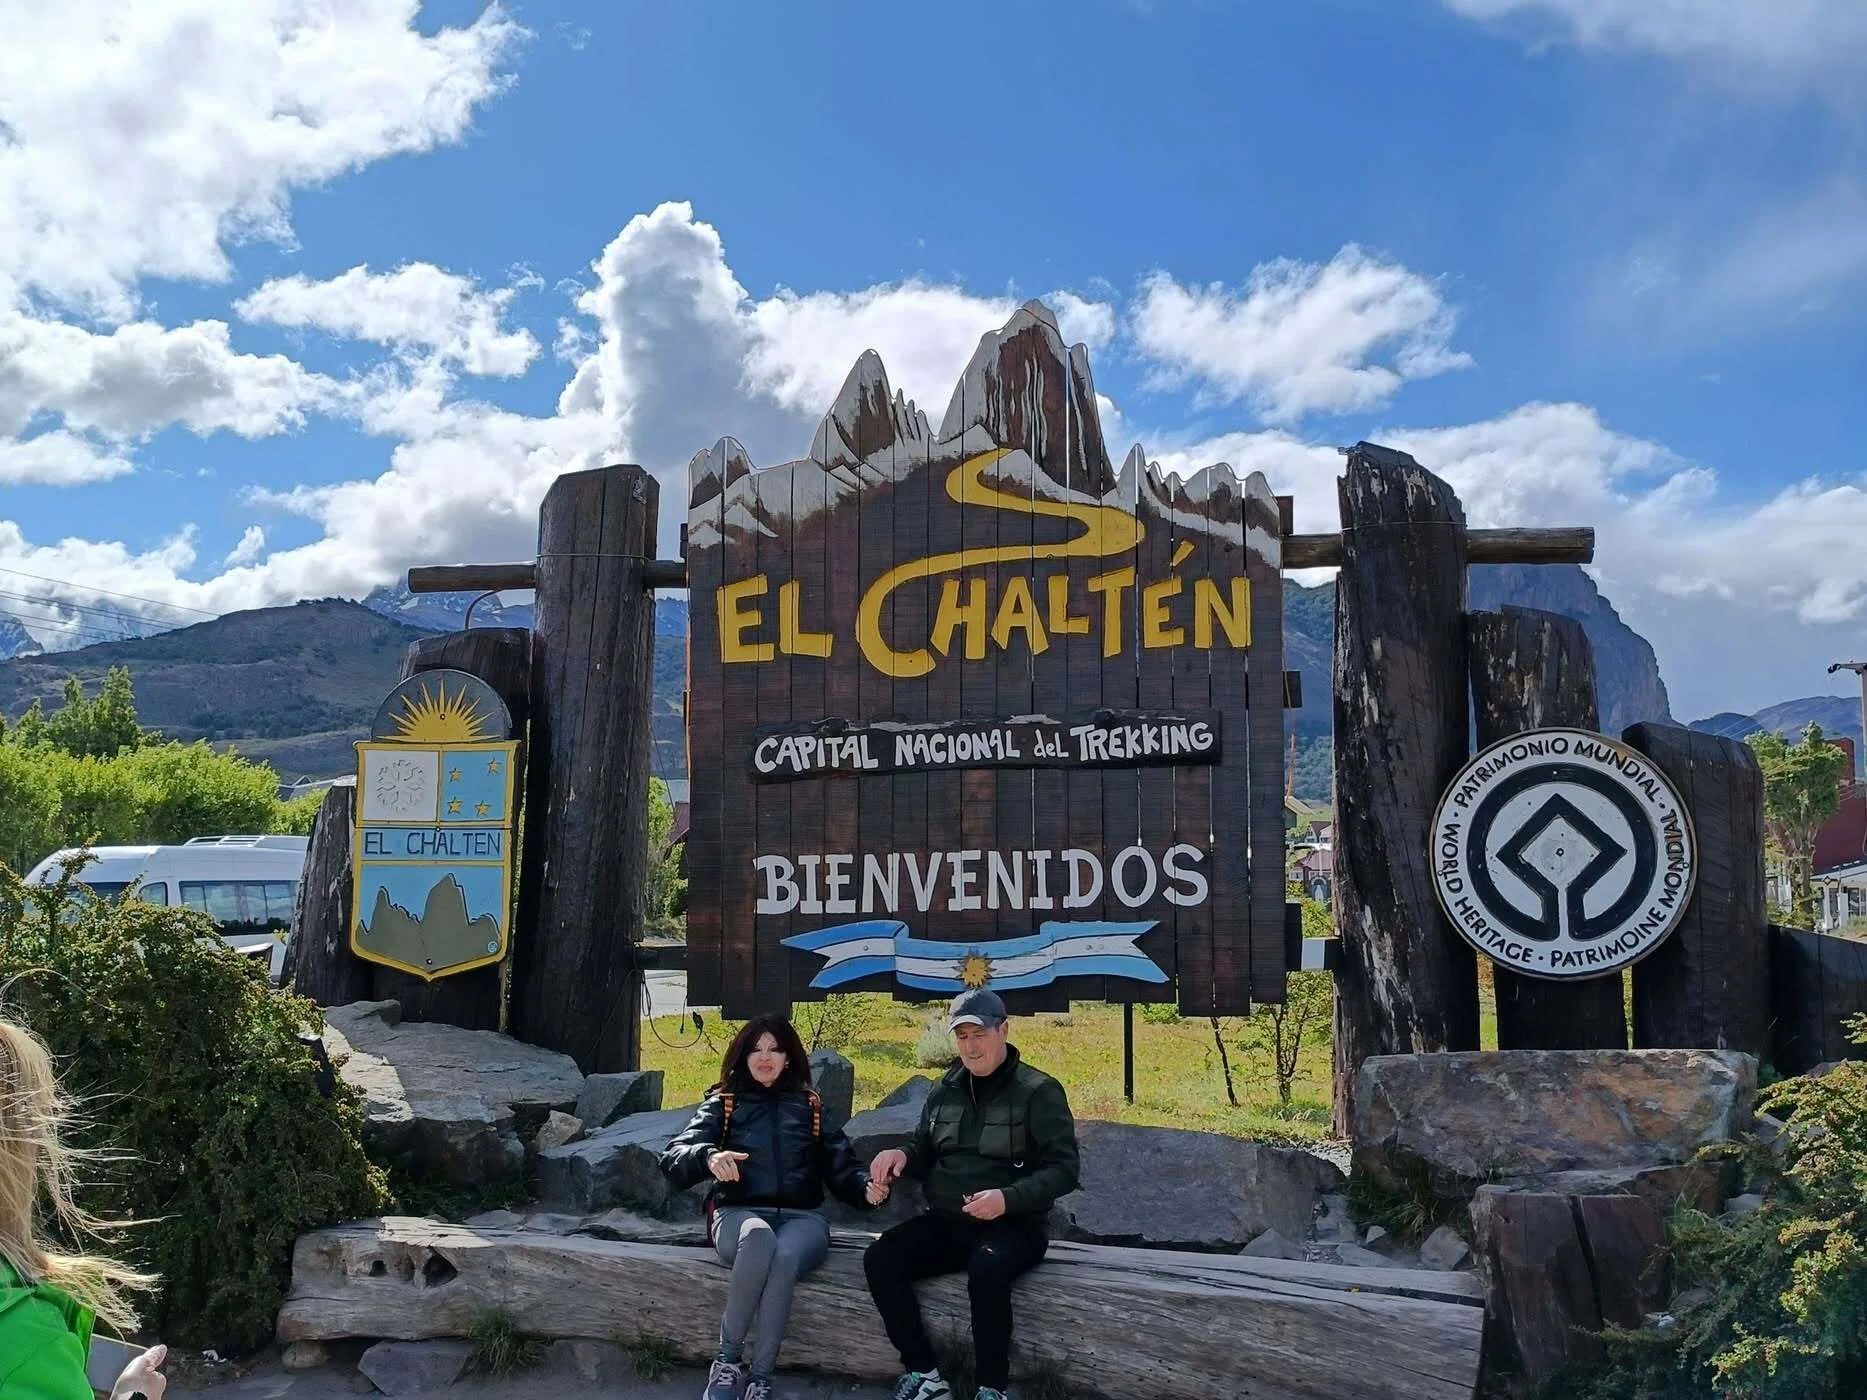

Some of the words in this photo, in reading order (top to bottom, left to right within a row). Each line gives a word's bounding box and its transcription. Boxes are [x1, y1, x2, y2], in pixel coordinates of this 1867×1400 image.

[716, 574, 834, 663] EL
[855, 540, 1253, 678] CHALTÉN
[753, 734, 879, 773] CAPITAL
[894, 727, 1021, 765] NACIONAL
[1070, 721, 1214, 760] TREKKING
[1453, 737, 1569, 809] PATRIMONIO
[1573, 739, 1663, 803] MUNDIAL
[364, 831, 392, 855] EL
[406, 831, 501, 856] CHALTEN
[752, 842, 1210, 915] BIENVENIDOS
[1441, 823, 1464, 895] WORLD
[1454, 896, 1533, 964] HERITAGE
[1550, 906, 1667, 968] PATRIMOINE
[1659, 808, 1685, 909] MONDIAL
